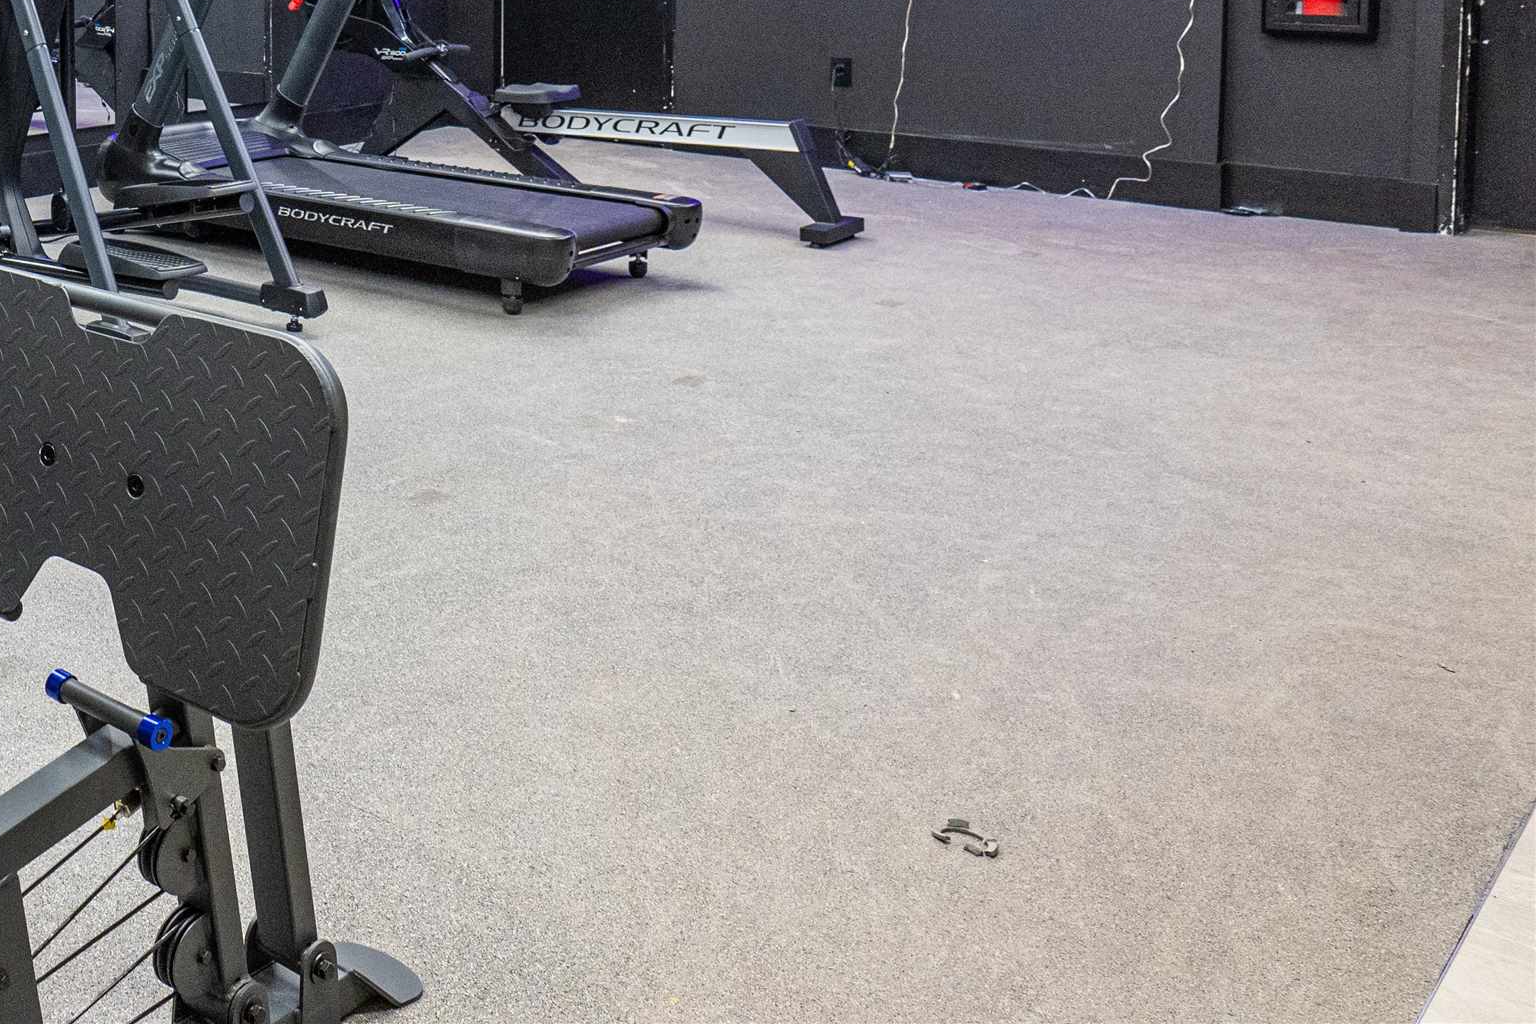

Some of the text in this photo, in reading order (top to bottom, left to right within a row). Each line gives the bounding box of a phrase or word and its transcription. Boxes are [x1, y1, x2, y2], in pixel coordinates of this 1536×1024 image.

[144, 51, 165, 104] EXP
[517, 113, 737, 140] BODYCRAFT
[277, 205, 395, 235] BODYCRAFT
